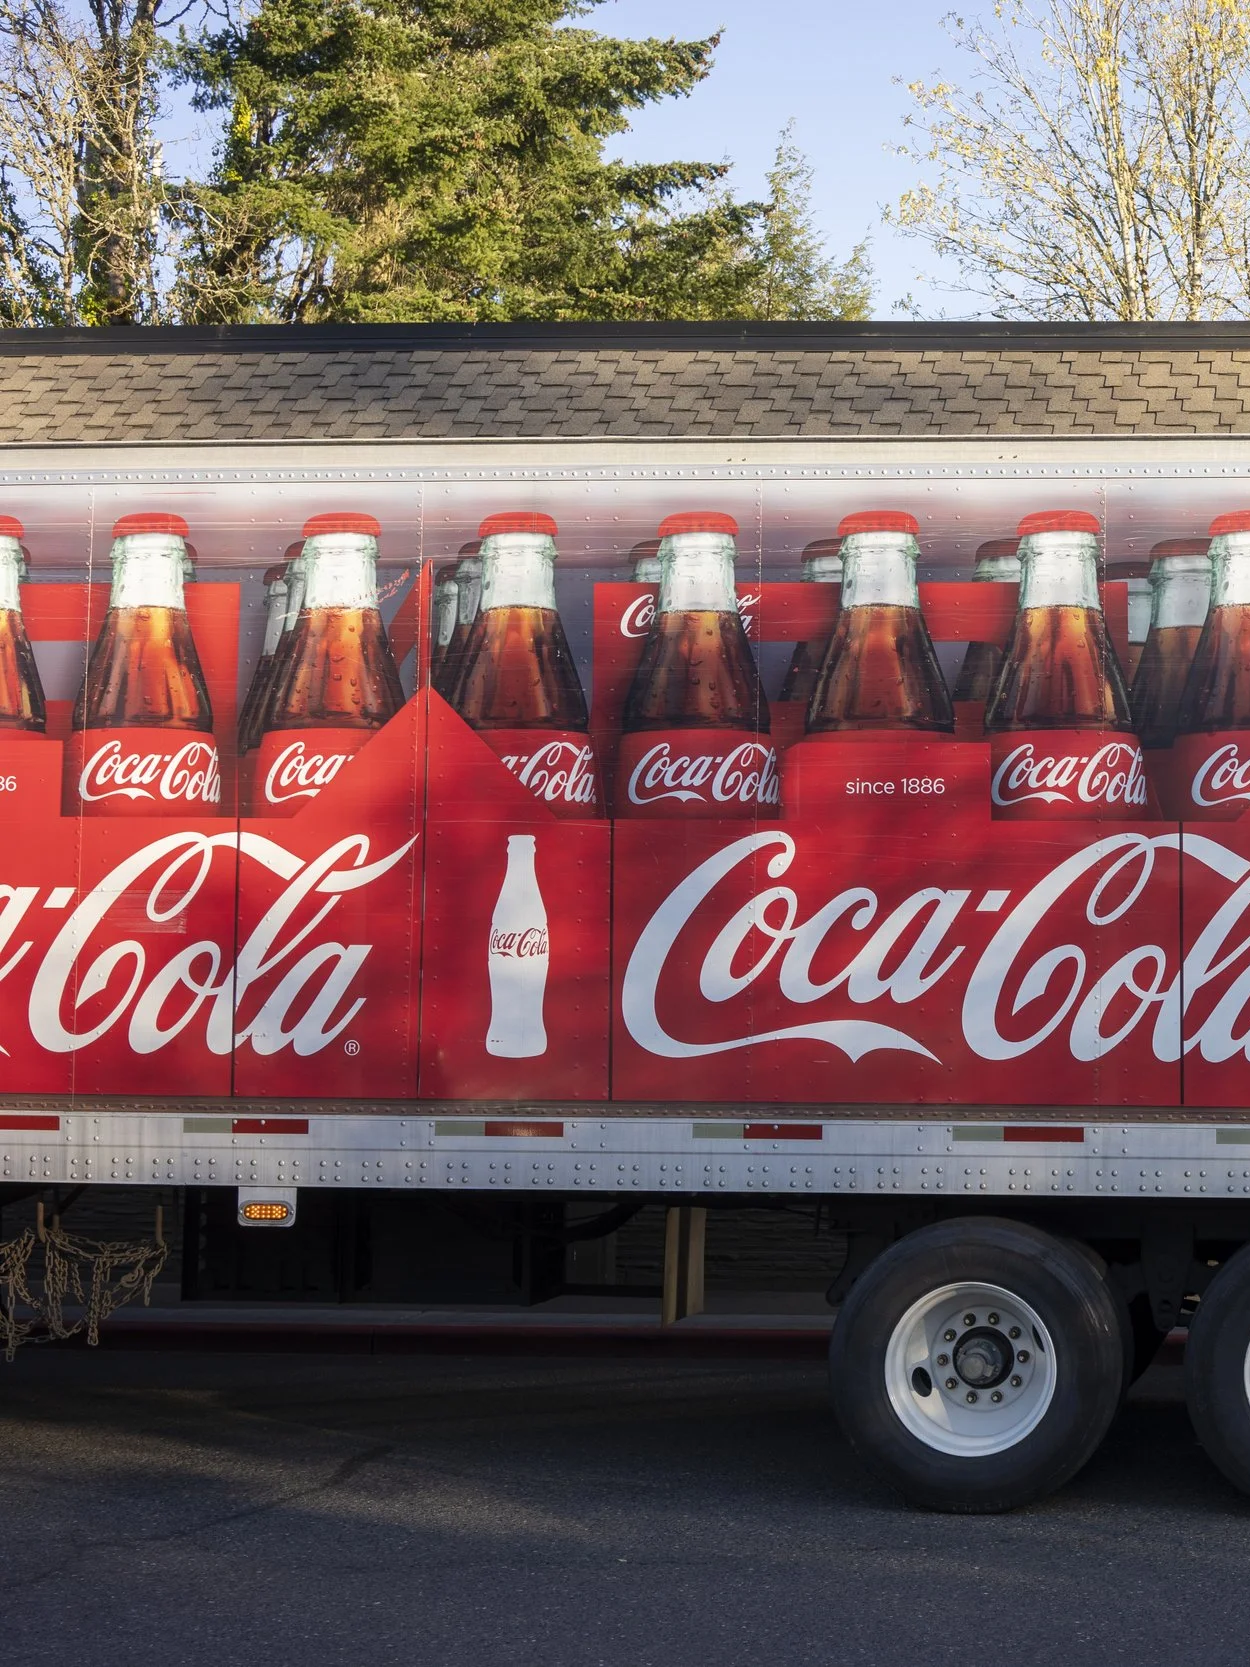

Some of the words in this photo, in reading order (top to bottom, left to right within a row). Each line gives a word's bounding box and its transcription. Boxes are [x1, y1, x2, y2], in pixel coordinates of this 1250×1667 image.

[78, 740, 221, 803] Coca-Cola
[628, 742, 780, 804] Coca-Cola
[846, 778, 895, 794] since
[901, 778, 946, 794] 1886
[991, 743, 1148, 806] Coca-Cola
[490, 927, 548, 958] Coca-Cola
